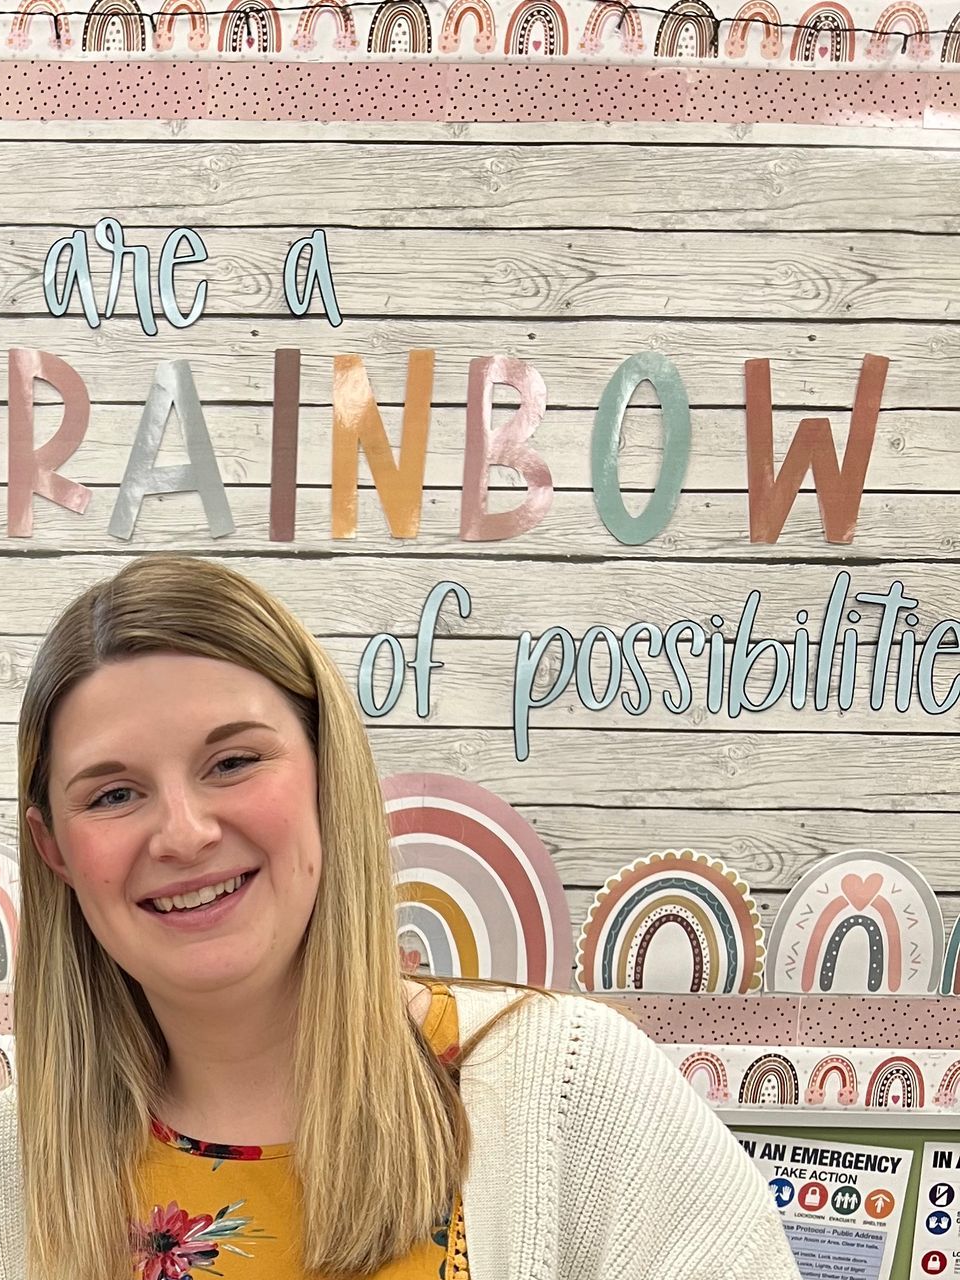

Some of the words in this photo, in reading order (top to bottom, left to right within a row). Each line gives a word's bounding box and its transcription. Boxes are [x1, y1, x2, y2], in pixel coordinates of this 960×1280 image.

[44, 217, 208, 336] are
[283, 229, 343, 328] a
[7, 348, 889, 546] RAINBOW
[358, 580, 472, 718] of
[760, 1143, 786, 1162] AN
[790, 1146, 902, 1174] EMERGENCY
[932, 1150, 952, 1168] IN
[774, 1166, 807, 1179] TAKE
[809, 1170, 858, 1185] ACTION
[796, 1224, 826, 1234] Protocol
[832, 1229, 853, 1238] Public
[855, 1232, 883, 1241] Address
